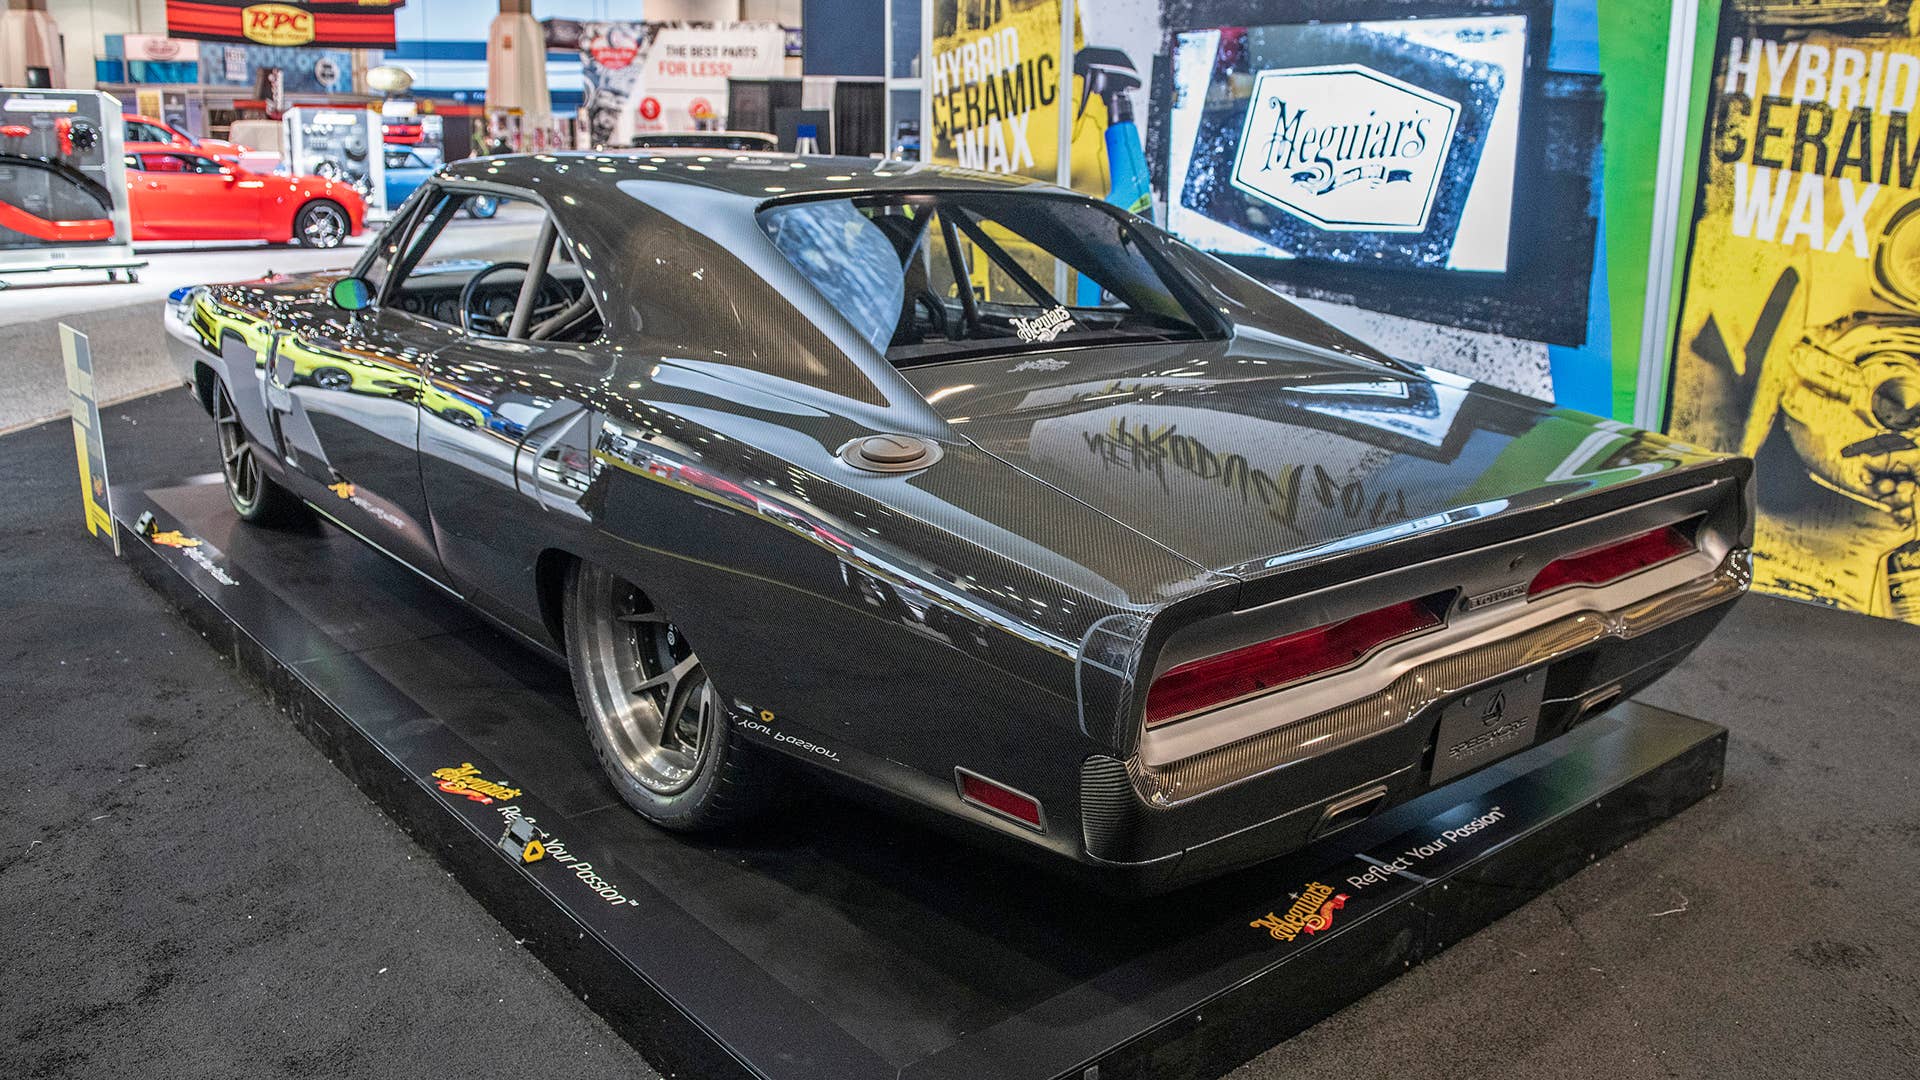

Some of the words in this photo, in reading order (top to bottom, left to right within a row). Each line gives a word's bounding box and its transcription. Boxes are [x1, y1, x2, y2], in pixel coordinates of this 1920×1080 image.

[248, 8, 308, 32] RPC
[658, 60, 688, 75] FOR
[691, 61, 733, 77] LESS!
[666, 45, 687, 57] THE
[690, 45, 718, 57] BEST
[722, 45, 758, 58] PARTS
[932, 26, 1020, 97] HYBRID
[1724, 36, 1920, 116] HYBRID
[932, 53, 1056, 136] CERAMIC
[955, 105, 1035, 175] WAX
[1261, 95, 1431, 196] Meguiar's
[1732, 162, 1870, 259] WAX
[1008, 304, 1071, 344] Meguiar's
[543, 838, 577, 870] Your
[1346, 856, 1414, 890] Reflect
[1405, 837, 1448, 860] Your
[1249, 881, 1335, 942] Meguiar's
